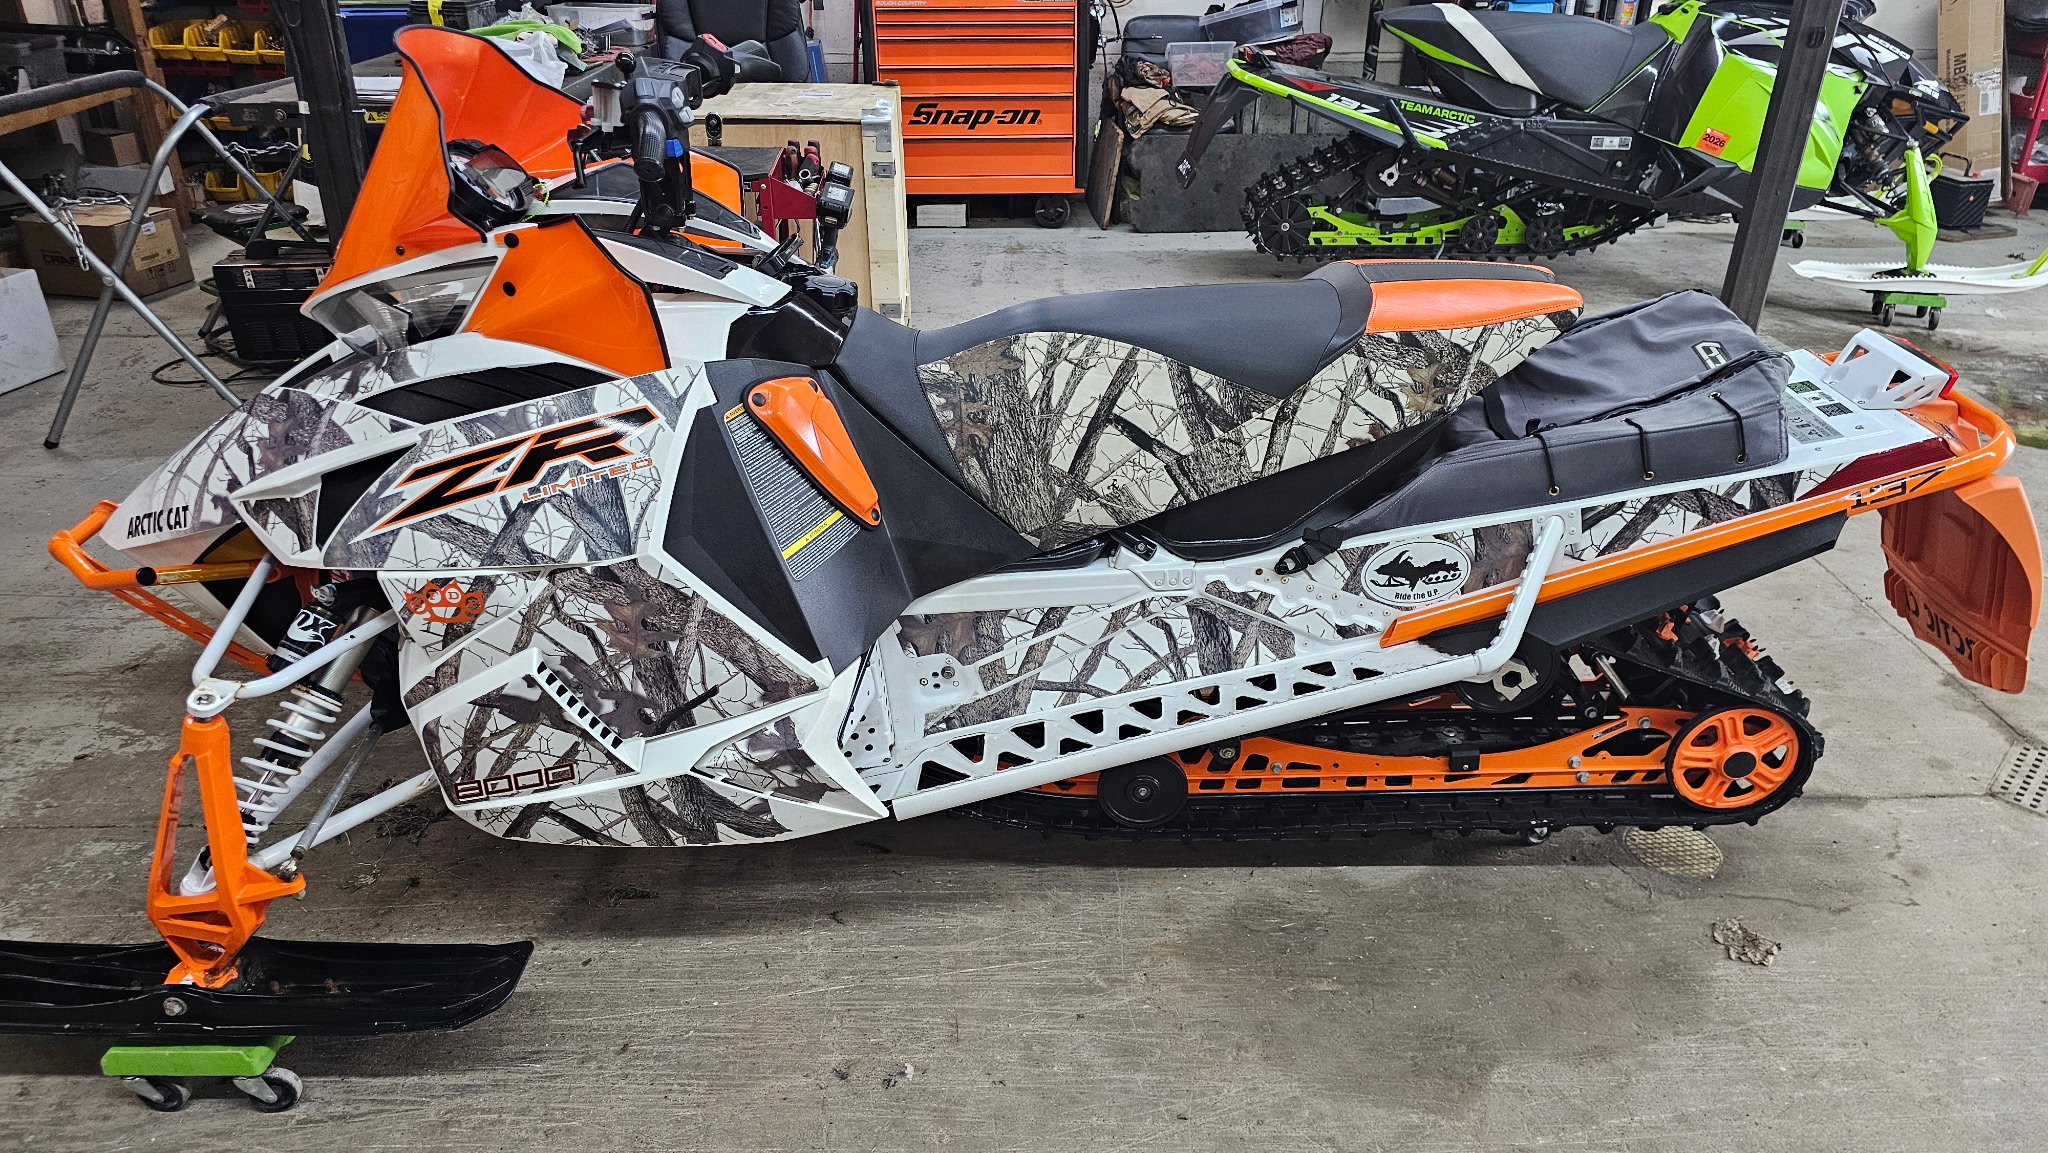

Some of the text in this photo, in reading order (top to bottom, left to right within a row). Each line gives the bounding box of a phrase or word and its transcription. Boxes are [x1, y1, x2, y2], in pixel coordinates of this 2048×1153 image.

[1325, 92, 1381, 114] 137
[1703, 133, 1726, 148] 2026
[371, 404, 660, 532] ZR
[522, 456, 654, 502] LIMITED
[1850, 466, 1947, 510] 137
[127, 505, 190, 539] ARCTIC CAT
[1394, 591, 1412, 600] Ride
[1413, 591, 1426, 600] the
[452, 761, 577, 800] 8000
